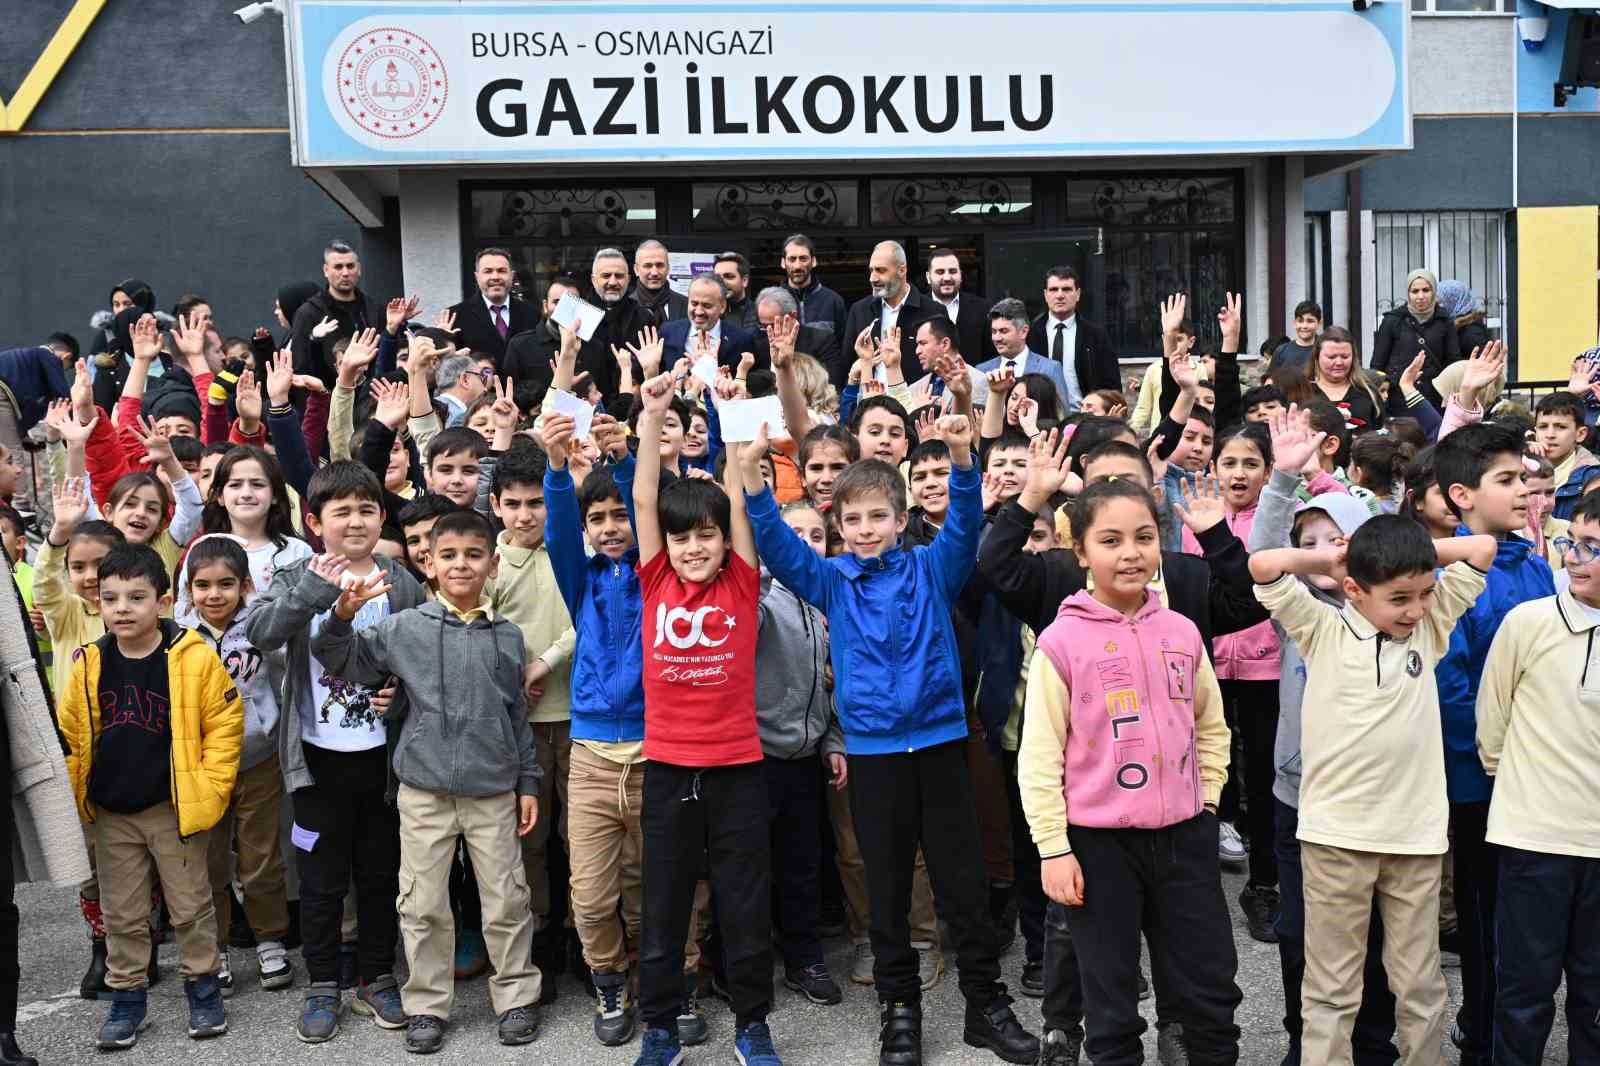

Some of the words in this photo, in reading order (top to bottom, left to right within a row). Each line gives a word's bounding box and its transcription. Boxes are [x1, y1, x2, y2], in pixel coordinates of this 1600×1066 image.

[471, 32, 569, 58] BURSA
[595, 25, 773, 56] OSMANGAZİ
[475, 62, 660, 138] GAZİ
[686, 61, 1054, 135] İLKOKULU
[1096, 656, 1149, 790] MELLO
